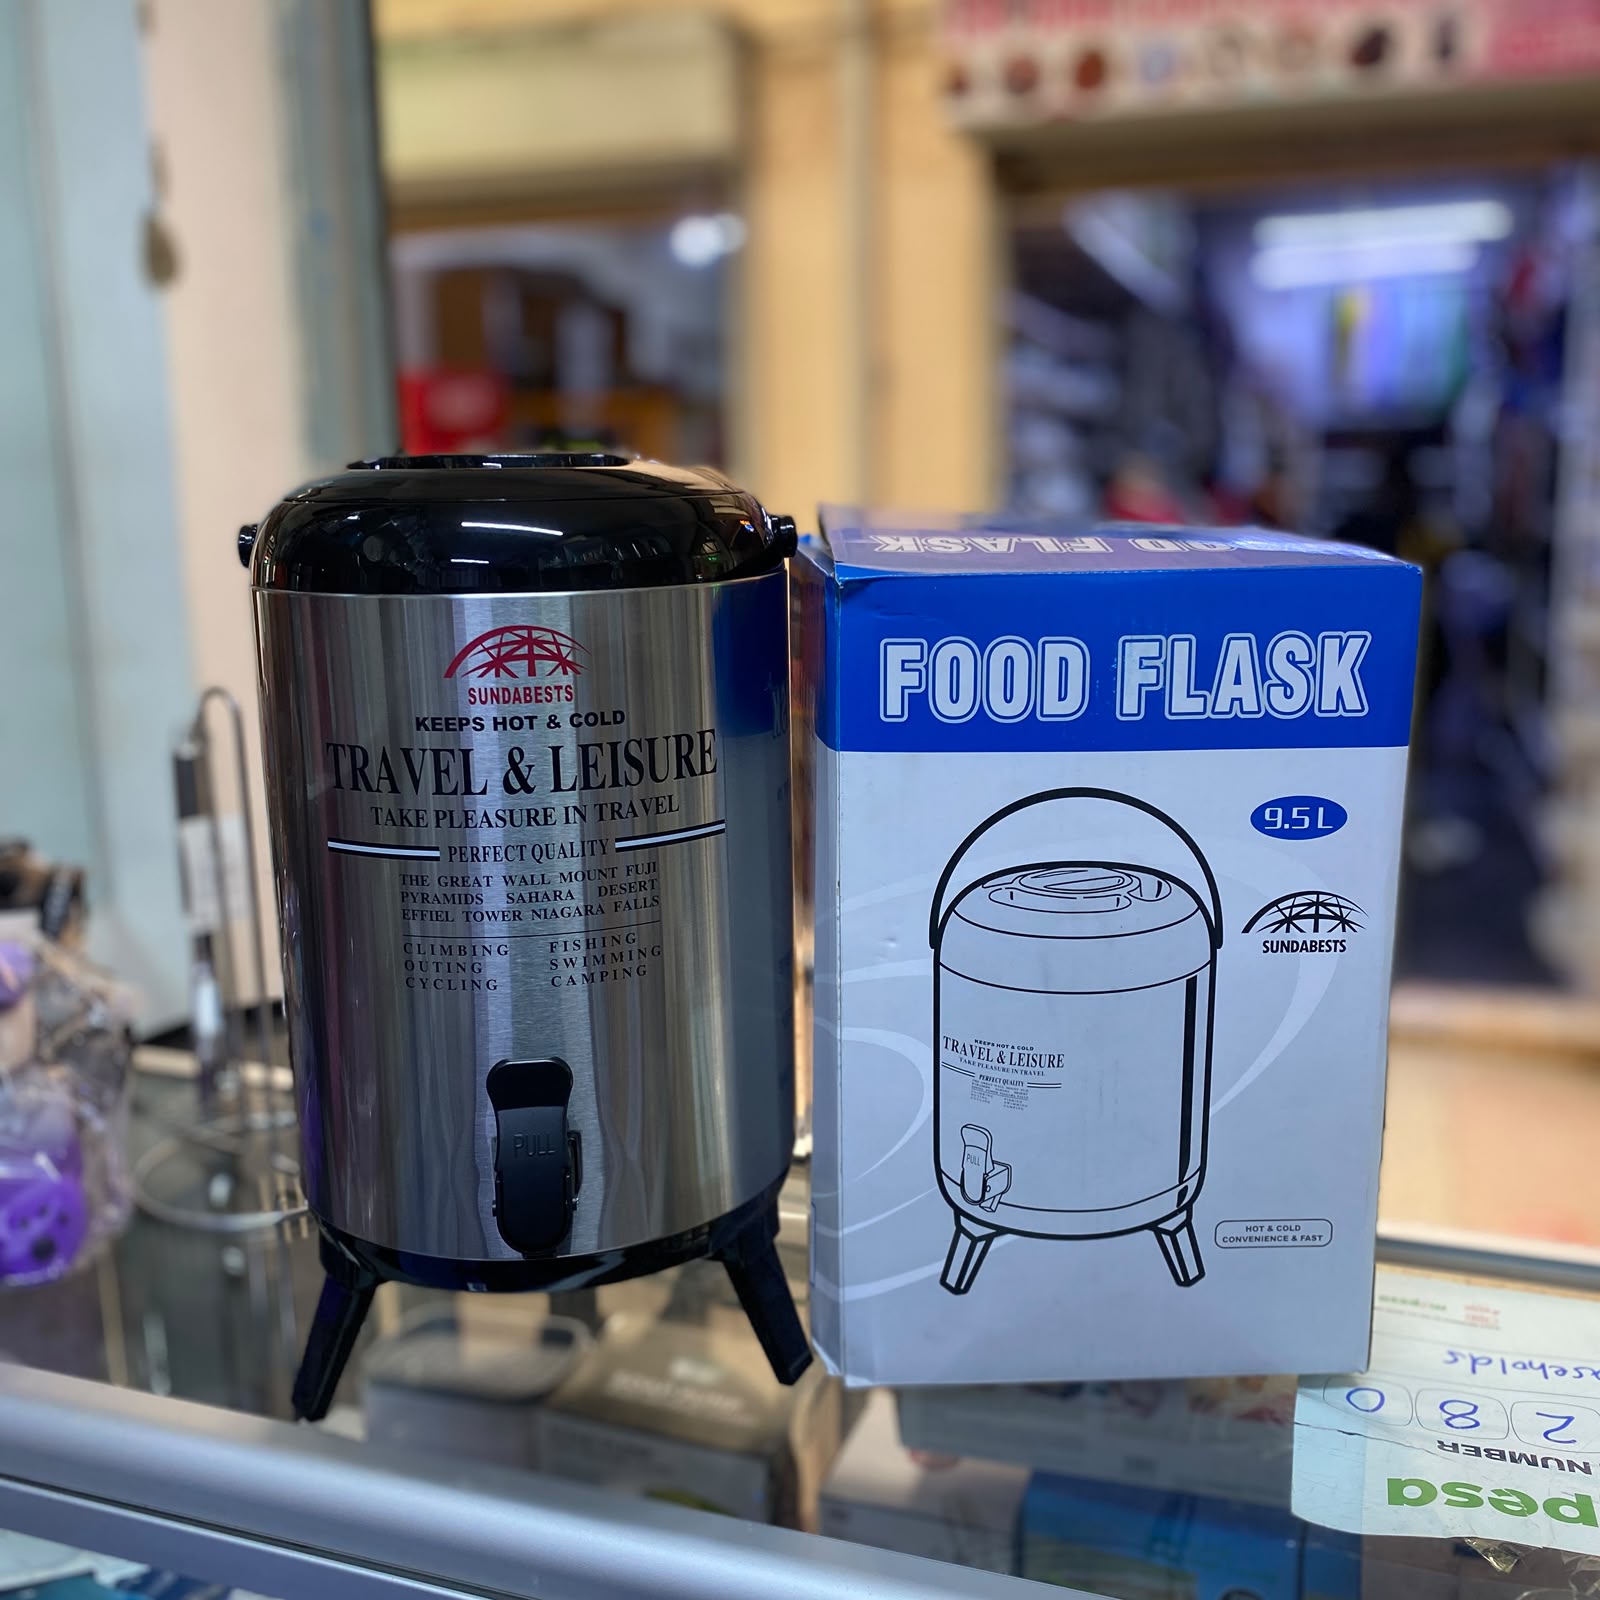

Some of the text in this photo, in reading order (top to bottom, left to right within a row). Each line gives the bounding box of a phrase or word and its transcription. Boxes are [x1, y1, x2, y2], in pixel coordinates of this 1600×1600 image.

[869, 535, 1115, 553] FLASK
[880, 631, 1372, 724] FOOD FLASK
[468, 684, 574, 705] SUNDABESTS
[415, 710, 626, 732] KEEPS HOT & COLD
[326, 728, 718, 796] TRAVEL & LEISURE
[371, 794, 680, 829] TAKE PLEASURE IN TRAVEL
[448, 838, 610, 863] PERFECT QUALITY
[400, 861, 658, 888] THE GREAT WALL MOUNT FUJI
[401, 878, 658, 905] PYRAMIDS SAHARA DESERT
[402, 895, 660, 923] EFFIEL TOWER NIAGARA FALLS
[403, 942, 510, 957] CLIMBING
[549, 932, 638, 954] FISHING
[1262, 939, 1347, 954] SUNDABESTS
[404, 960, 484, 975] OUTING
[549, 944, 662, 971] SWIMMING
[405, 976, 499, 991] CYCLING
[551, 964, 648, 988] CAMPING
[943, 1035, 1065, 1069] TRAVEL & LEISURE
[974, 1038, 995, 1047] KEEPS
[959, 1057, 976, 1067] TAKE
[977, 1061, 1010, 1074] PLEASURE
[1020, 1069, 1046, 1077] TRAVEL
[979, 1074, 1024, 1088] PERFECT QUALITY
[513, 1133, 556, 1158] PULL
[966, 1153, 981, 1167] PULL
[1222, 1235, 1289, 1243] CONVENIENCE
[1300, 1234, 1323, 1242] FAST
[1276, 1224, 1301, 1232] COLD
[1437, 1440, 1593, 1476] NUMBER
